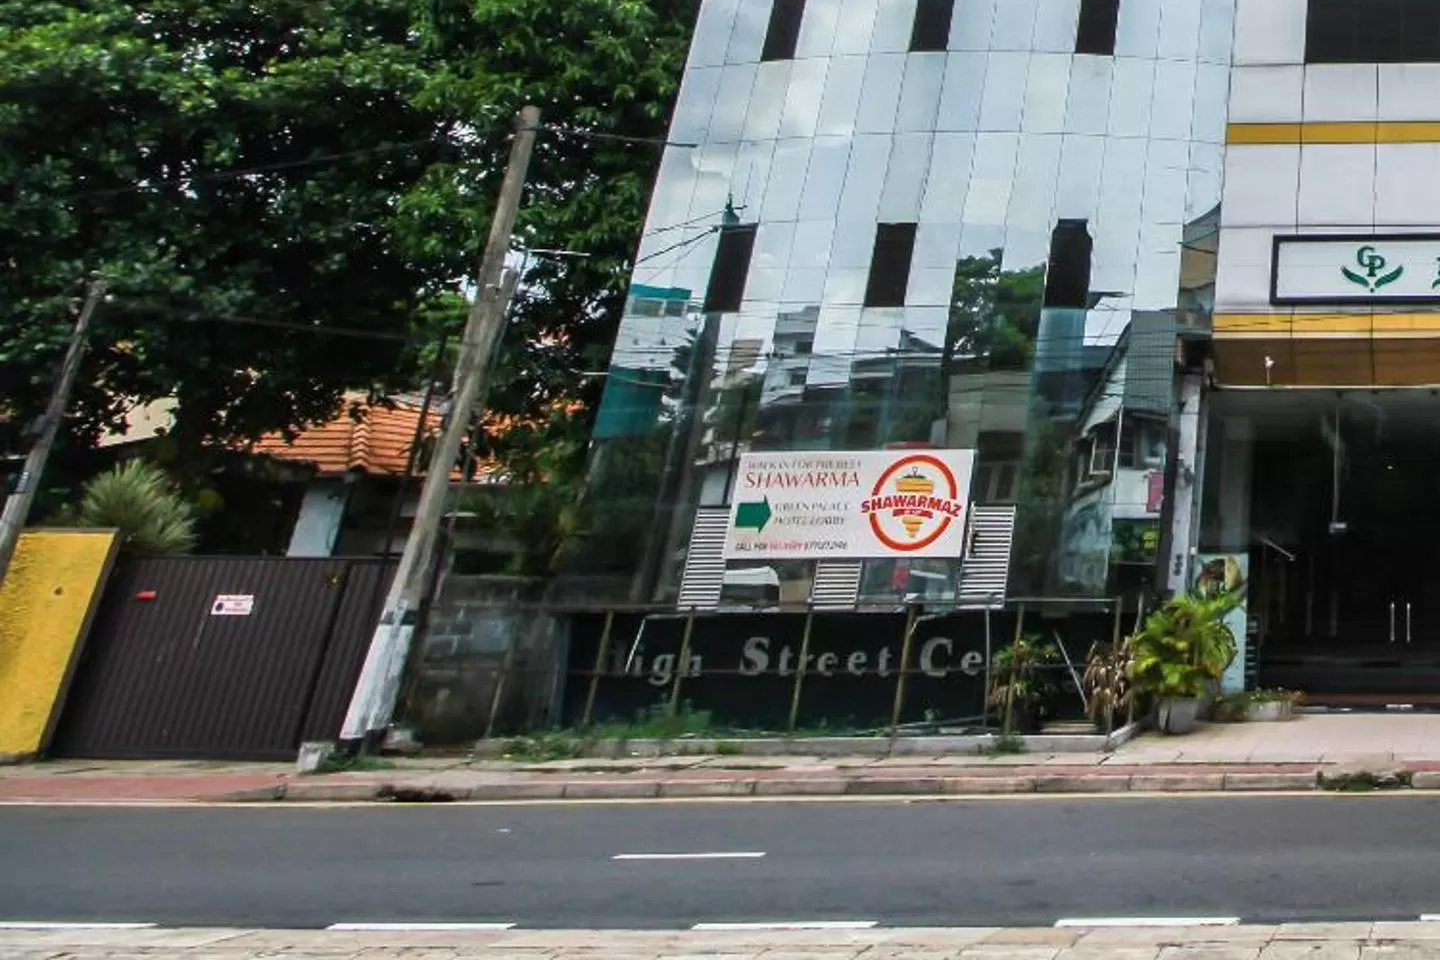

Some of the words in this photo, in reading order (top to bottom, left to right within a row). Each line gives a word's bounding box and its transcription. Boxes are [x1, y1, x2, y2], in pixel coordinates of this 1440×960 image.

[744, 471, 860, 489] SHAWARMA
[861, 494, 962, 517] SHAWARMAZ
[739, 637, 892, 677] Street
[919, 637, 986, 677] Ce
